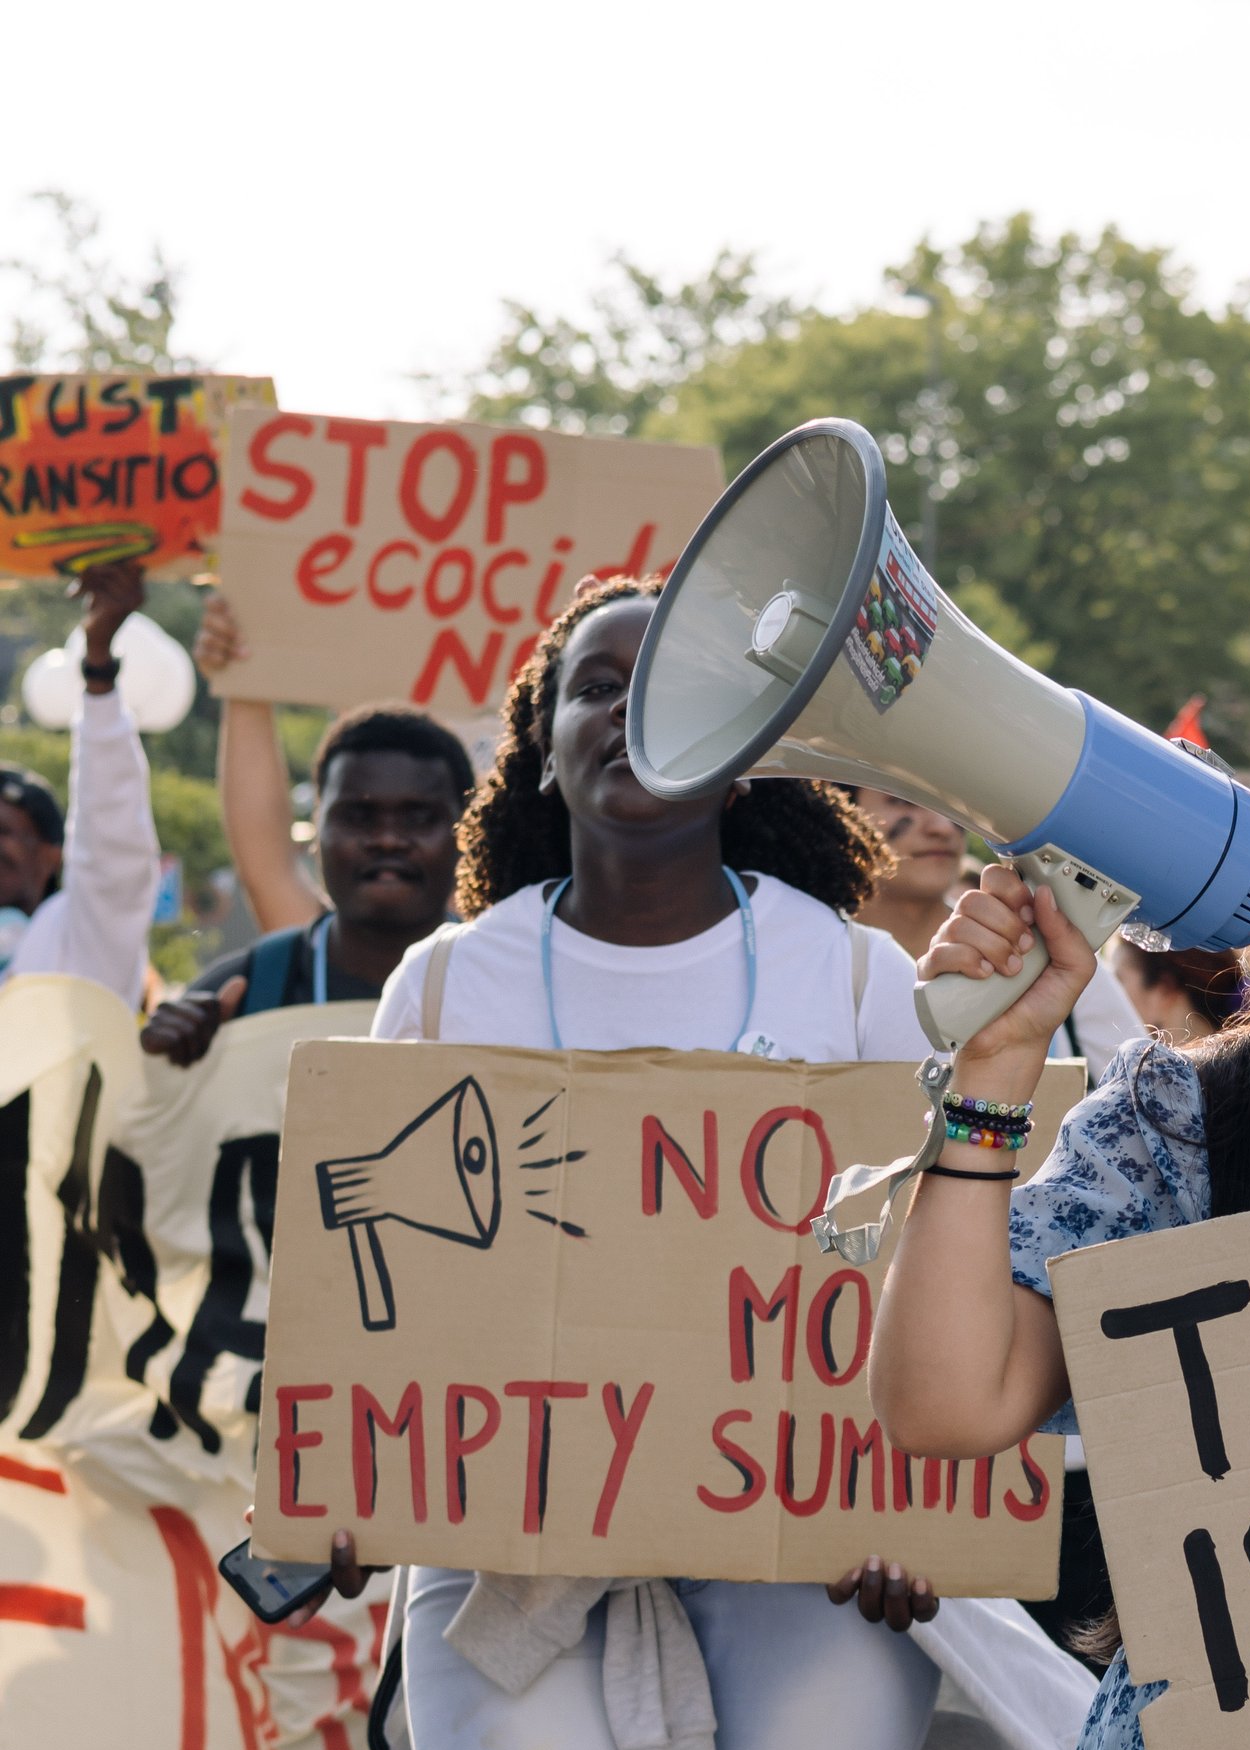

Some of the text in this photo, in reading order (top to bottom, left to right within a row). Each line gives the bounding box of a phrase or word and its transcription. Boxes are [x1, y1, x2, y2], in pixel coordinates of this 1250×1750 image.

[240, 414, 548, 545] STOP
[296, 522, 680, 627] ecocid
[642, 1105, 837, 1235] NO
[274, 1379, 656, 1538] EMPTY
